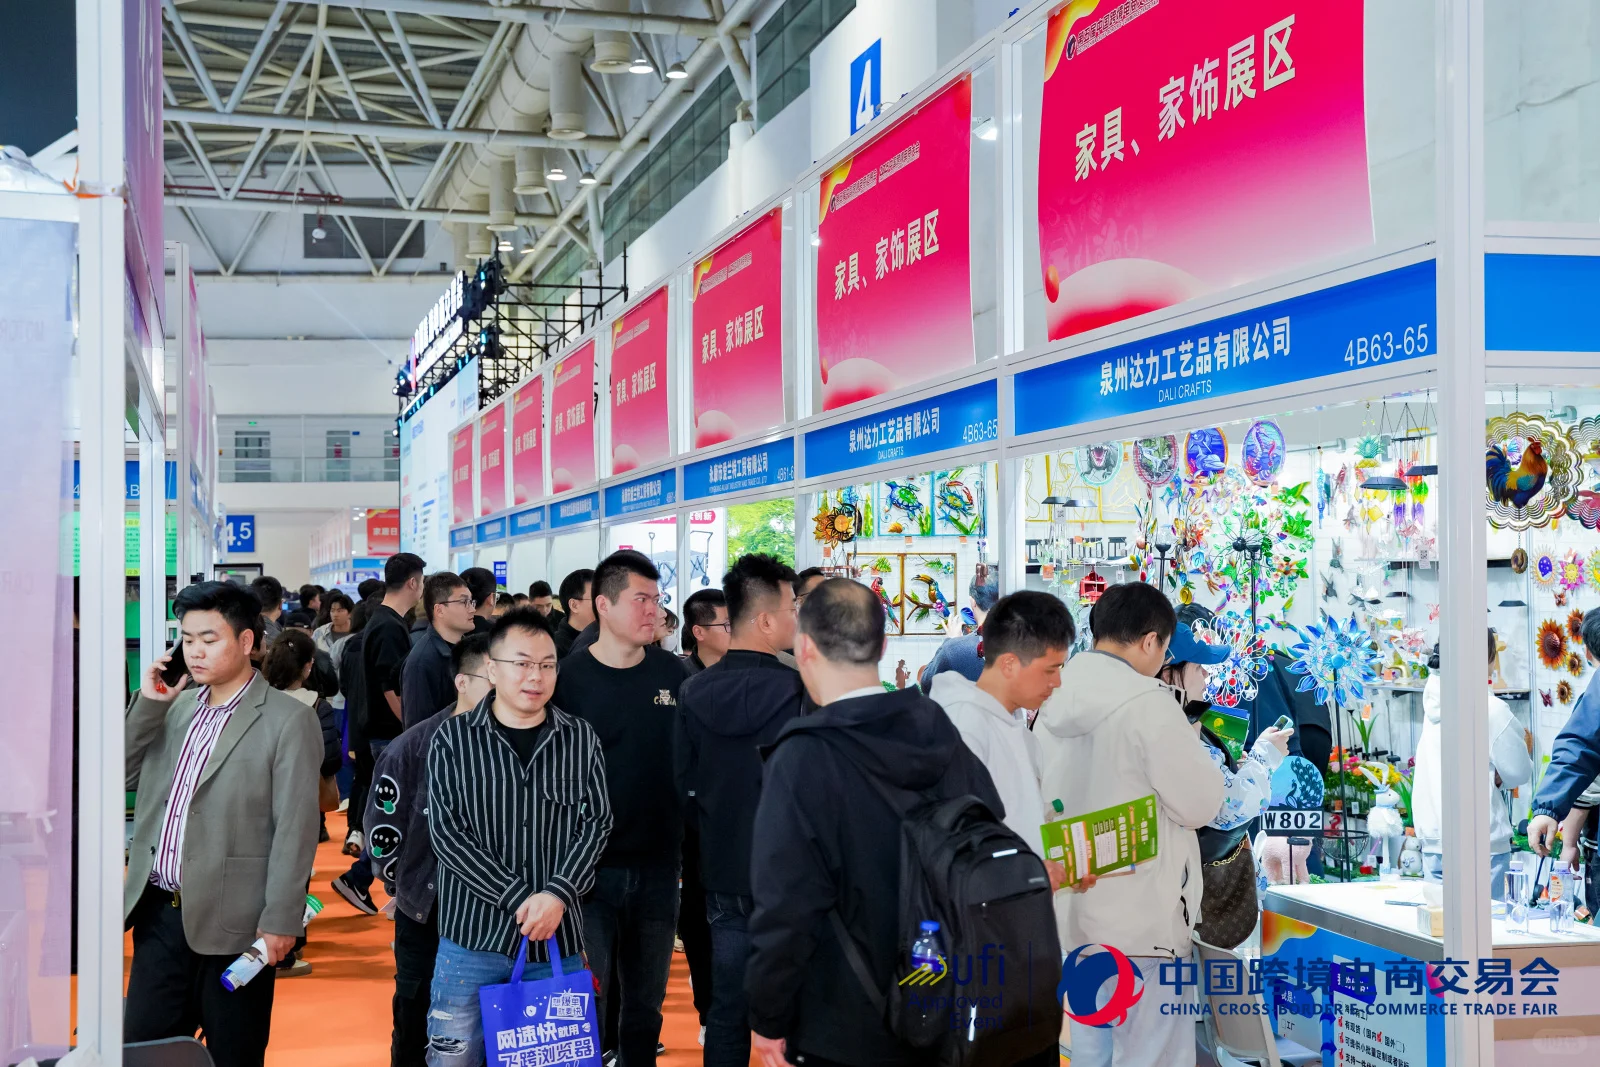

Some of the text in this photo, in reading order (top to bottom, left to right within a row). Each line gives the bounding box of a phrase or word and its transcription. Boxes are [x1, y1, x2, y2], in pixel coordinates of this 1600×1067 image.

[856, 59, 875, 130] 4
[1075, 14, 1296, 182] 家具、家饰展区
[834, 208, 940, 301] 家具、家饰展区
[702, 305, 764, 364] 家具、家饰展区
[1100, 315, 1291, 396] 泉州达力工艺品有限公司
[1343, 323, 1429, 367] 4B63-65
[1158, 379, 1212, 403] DALI CRAFTS
[849, 407, 940, 454] 泉州达力工艺品有限公司
[887, 446, 903, 458] CRAFTS
[962, 418, 998, 443] 4B63-65
[1264, 812, 1321, 829] W802
